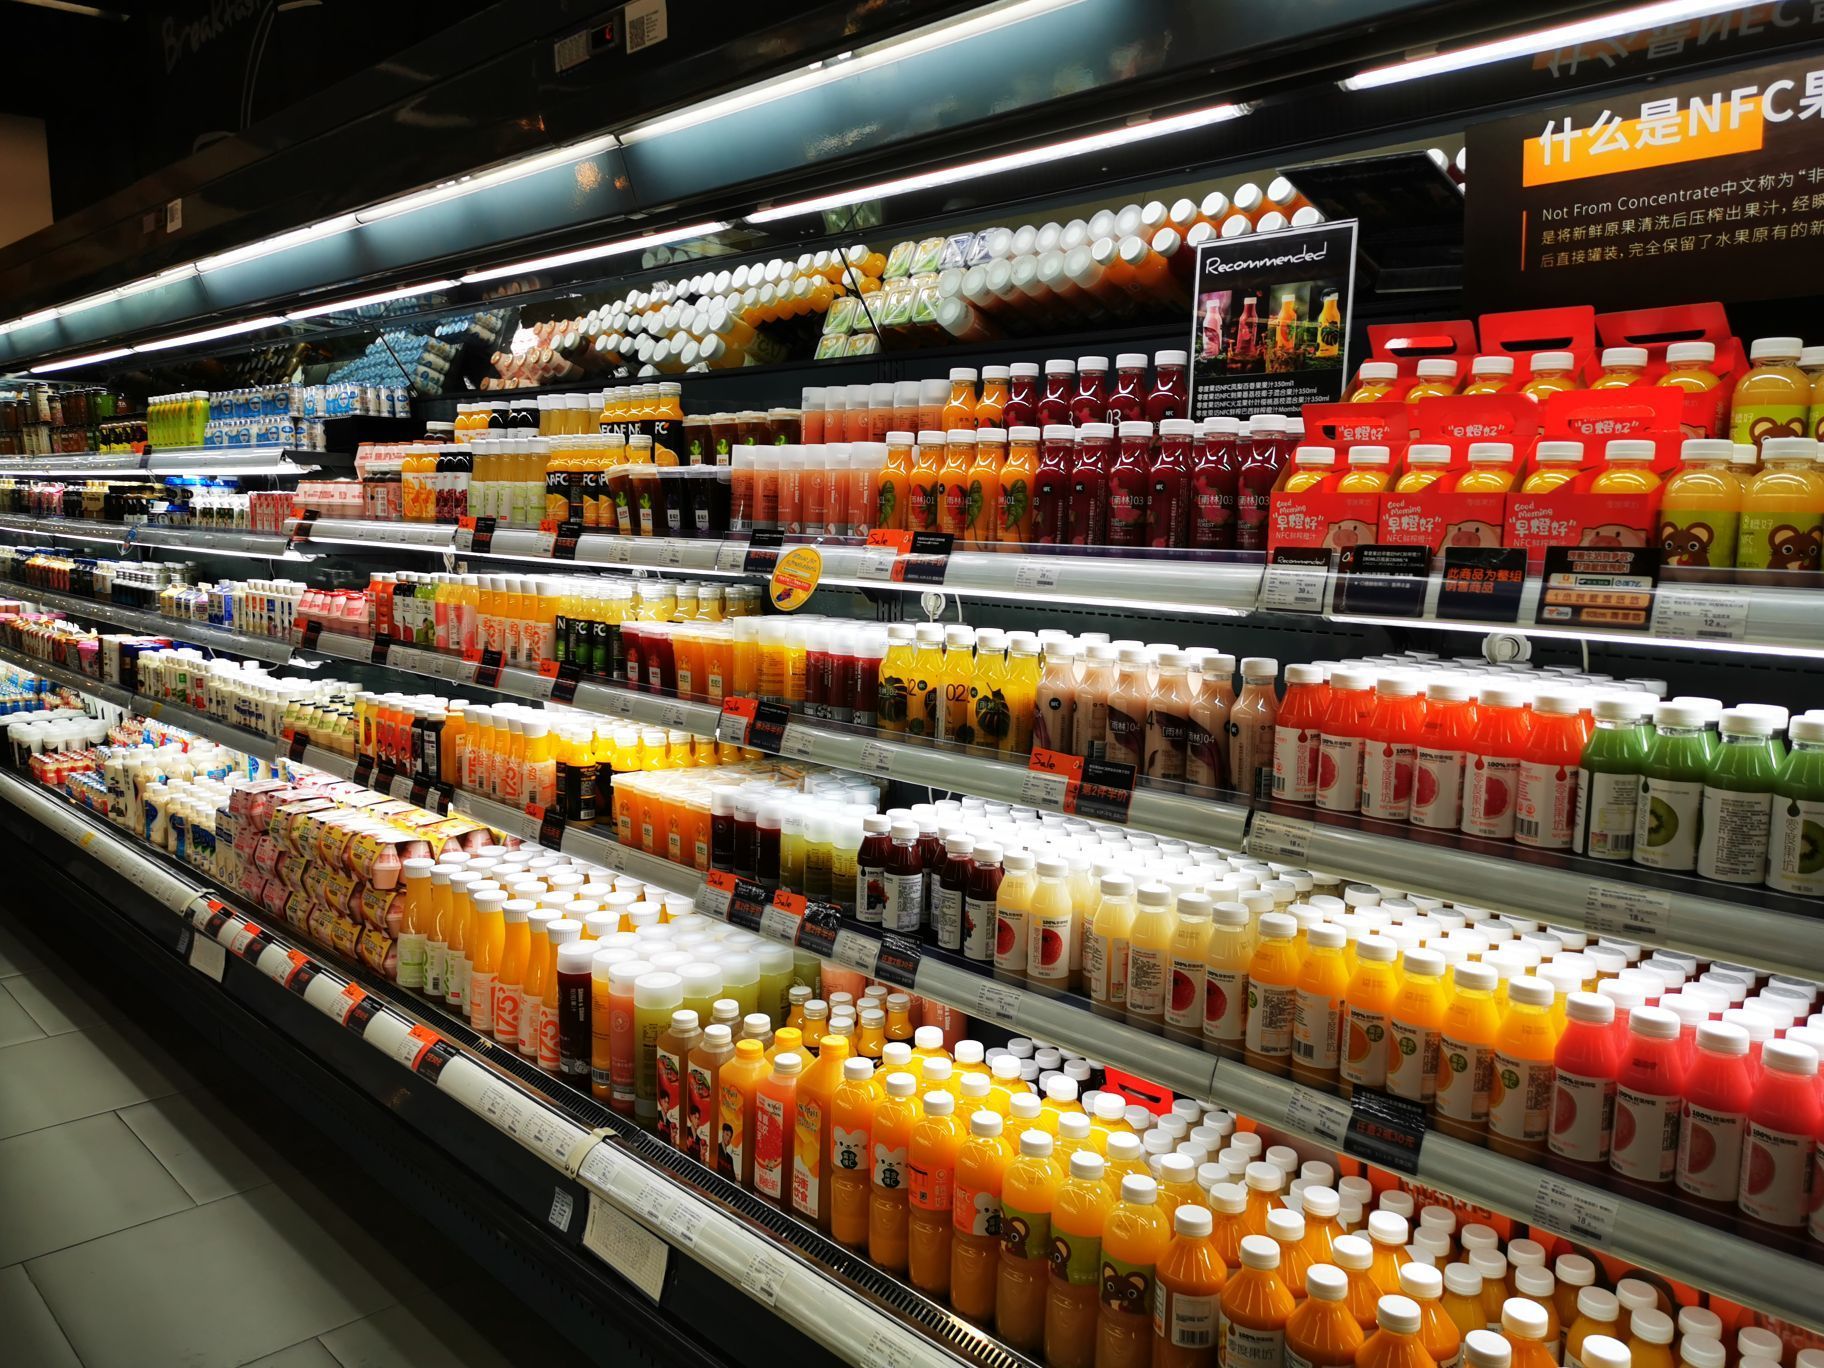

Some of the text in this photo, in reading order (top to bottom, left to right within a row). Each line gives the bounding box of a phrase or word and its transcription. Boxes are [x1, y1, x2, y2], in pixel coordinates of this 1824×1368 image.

[1542, 207, 1569, 222] Not
[1574, 199, 1612, 217] From
[1205, 241, 1328, 275] Recommended
[1276, 499, 1292, 508] Good
[1279, 505, 1307, 514] Morning
[1387, 499, 1405, 508] Good
[1514, 500, 1535, 511] Good
[1390, 505, 1422, 515] Morning
[1518, 508, 1553, 519] Morning
[868, 532, 888, 546] Sale
[1277, 555, 1326, 566] Recommended
[1446, 567, 1523, 582] 此商品为整组
[1033, 752, 1056, 770] Sale
[1082, 781, 1128, 802] 第2件半价
[774, 894, 792, 909] Sale
